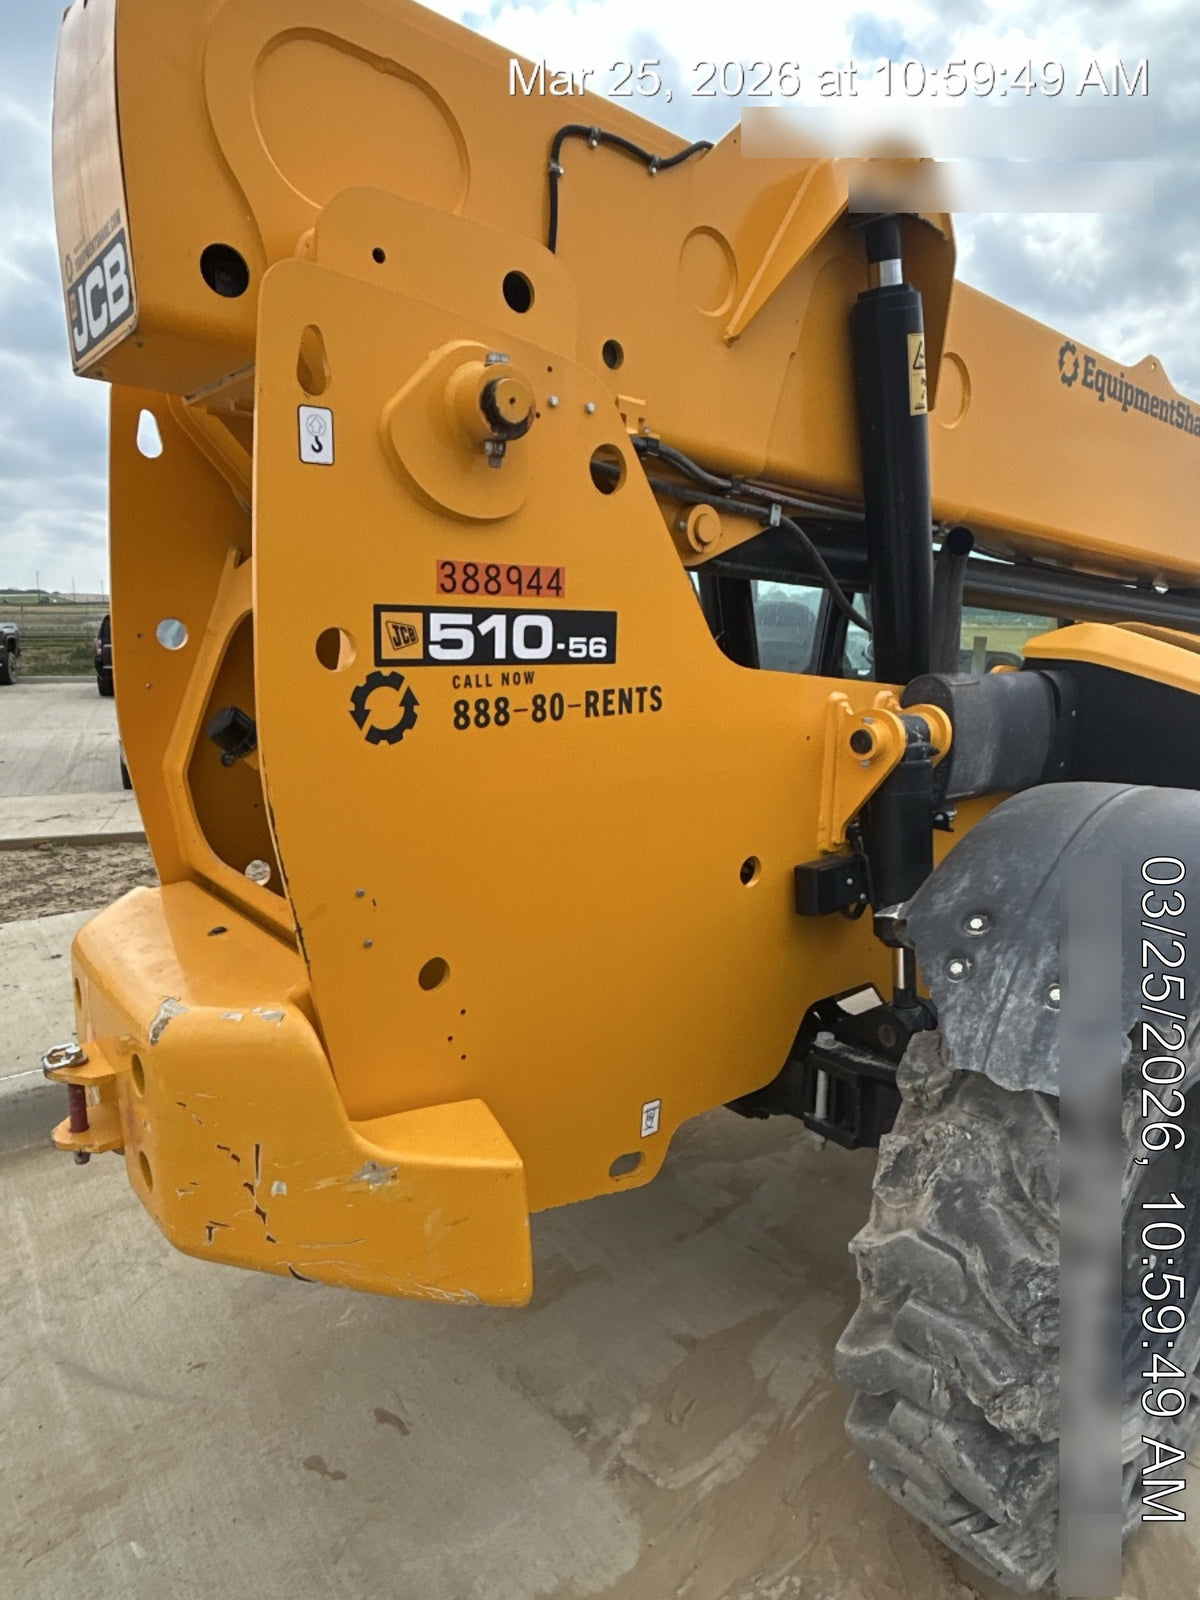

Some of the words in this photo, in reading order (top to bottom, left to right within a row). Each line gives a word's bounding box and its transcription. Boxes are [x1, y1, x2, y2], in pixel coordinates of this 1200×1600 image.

[73, 242, 131, 352] JCB
[439, 561, 563, 597] 388944
[390, 624, 418, 646] JCB
[452, 674, 493, 689] CALL
[501, 671, 535, 687] NOW
[453, 685, 663, 730] 888-80-RENTS
